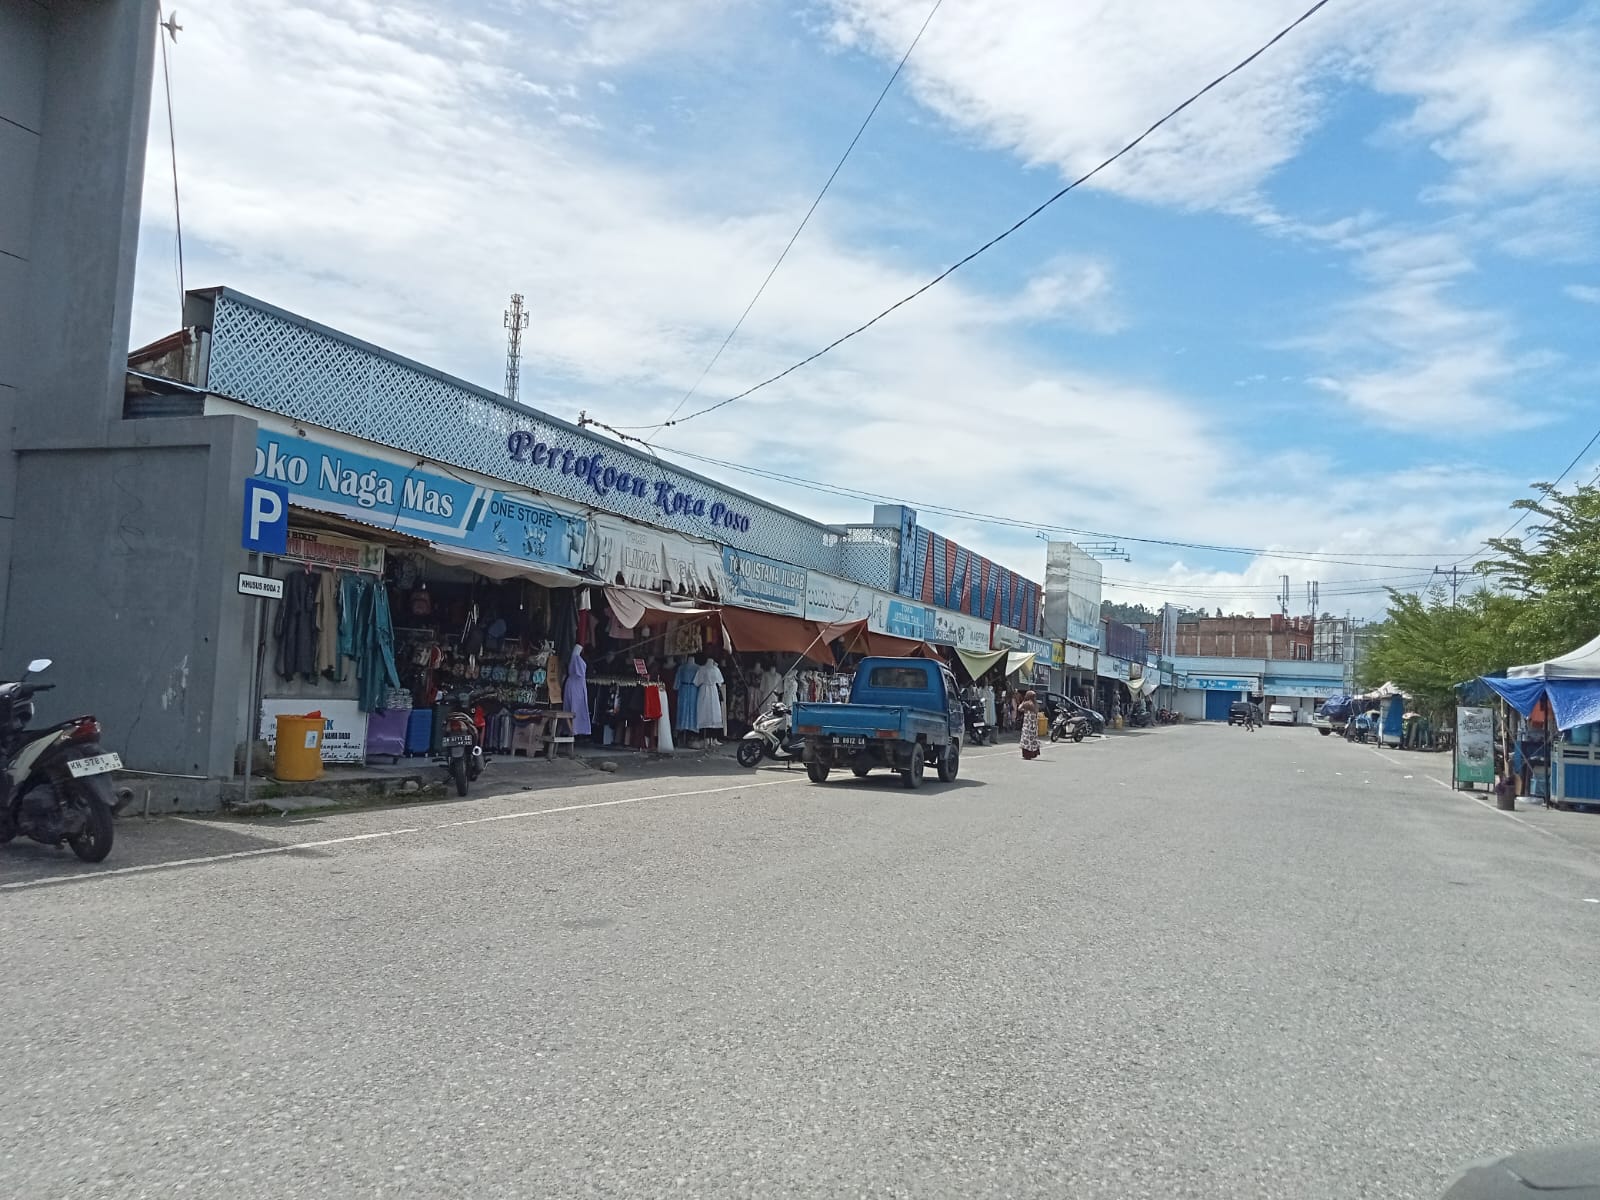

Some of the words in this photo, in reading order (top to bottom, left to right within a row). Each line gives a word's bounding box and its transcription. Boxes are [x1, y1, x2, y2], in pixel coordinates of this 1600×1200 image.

[254, 442, 308, 485] oko
[319, 455, 394, 508] Naga
[401, 475, 454, 518] Mas
[507, 430, 647, 498] Pertokoan
[654, 481, 706, 516] Kota
[710, 502, 751, 533] Poso
[250, 487, 282, 540] P
[490, 501, 515, 519] ONE
[517, 507, 553, 528] STORE
[625, 546, 660, 574] LIMA
[729, 554, 752, 578] TOKO
[752, 561, 779, 584] ISTANA
[781, 569, 804, 591] JILBAB
[241, 579, 263, 591] KHUSUS
[263, 583, 276, 592] RODA
[277, 585, 281, 593] 2
